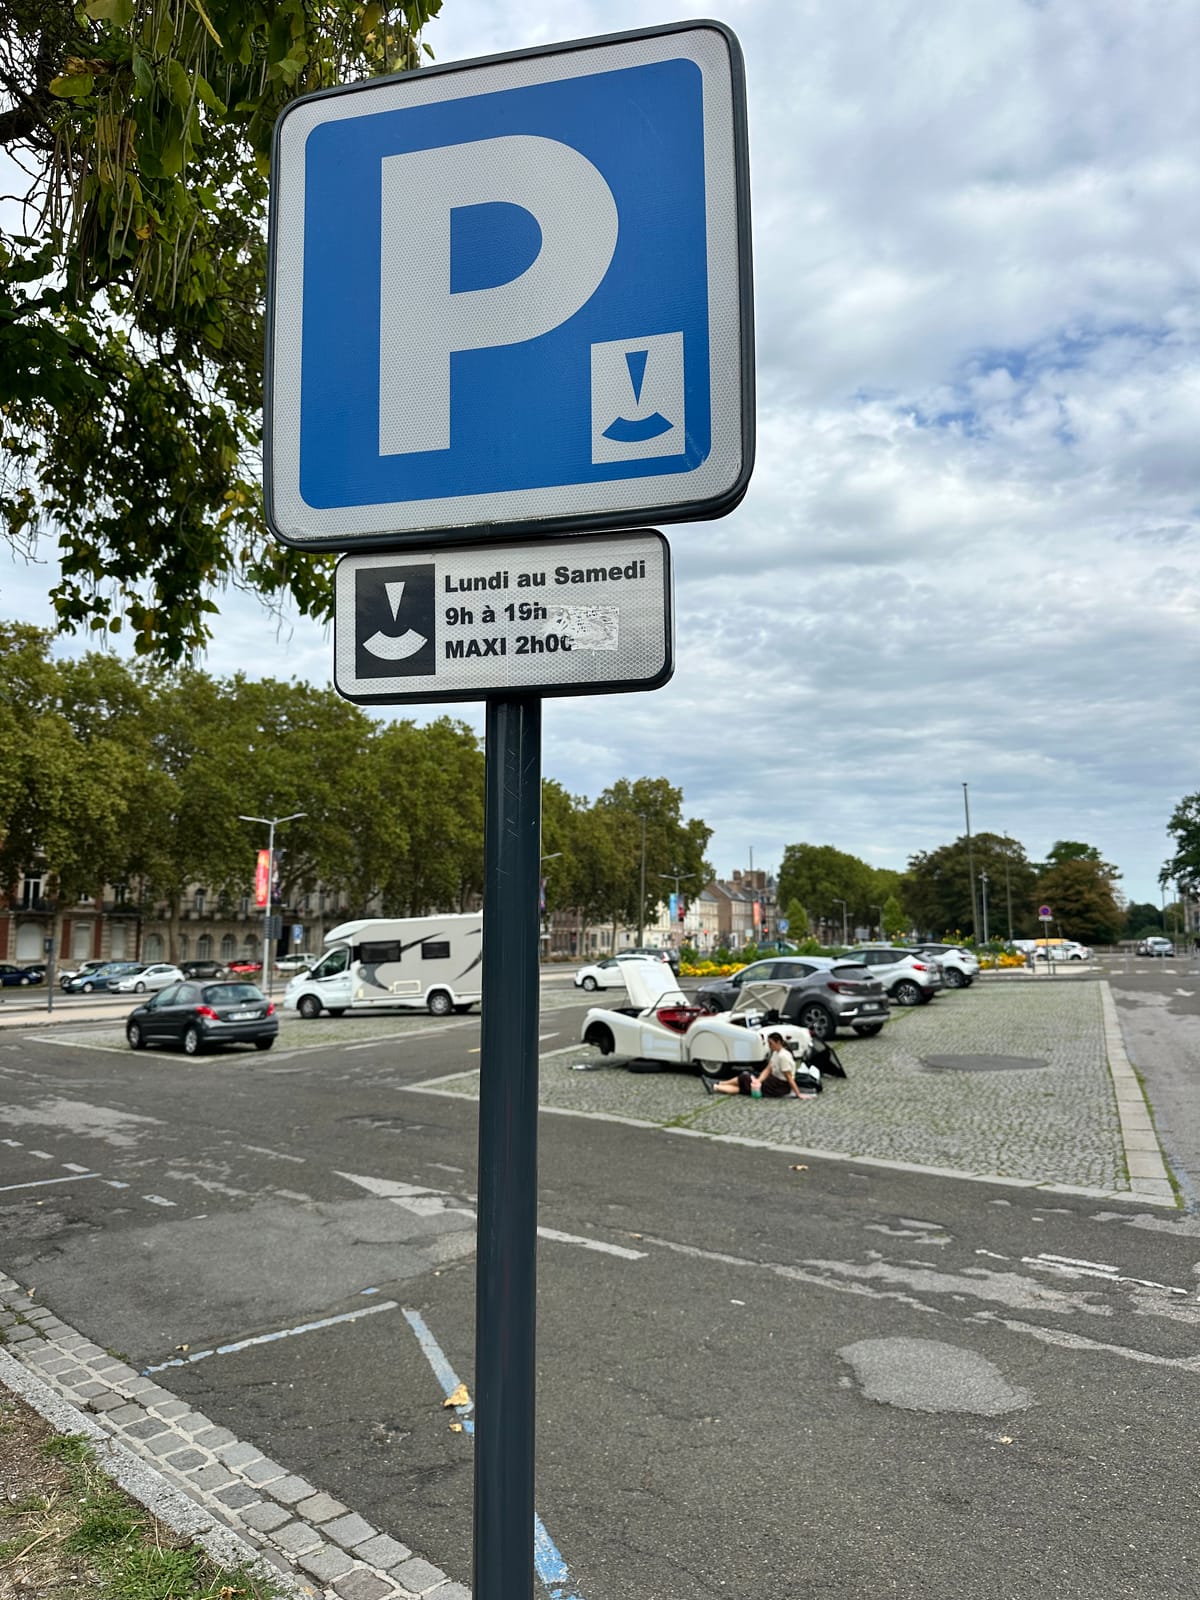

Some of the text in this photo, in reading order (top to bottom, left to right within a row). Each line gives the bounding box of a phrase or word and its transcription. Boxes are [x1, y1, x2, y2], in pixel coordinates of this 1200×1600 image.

[378, 134, 619, 457] P
[445, 560, 646, 592] Lundi au Samedi
[445, 606, 474, 625] 9h
[481, 605, 496, 623] à
[445, 637, 507, 658] MAXI
